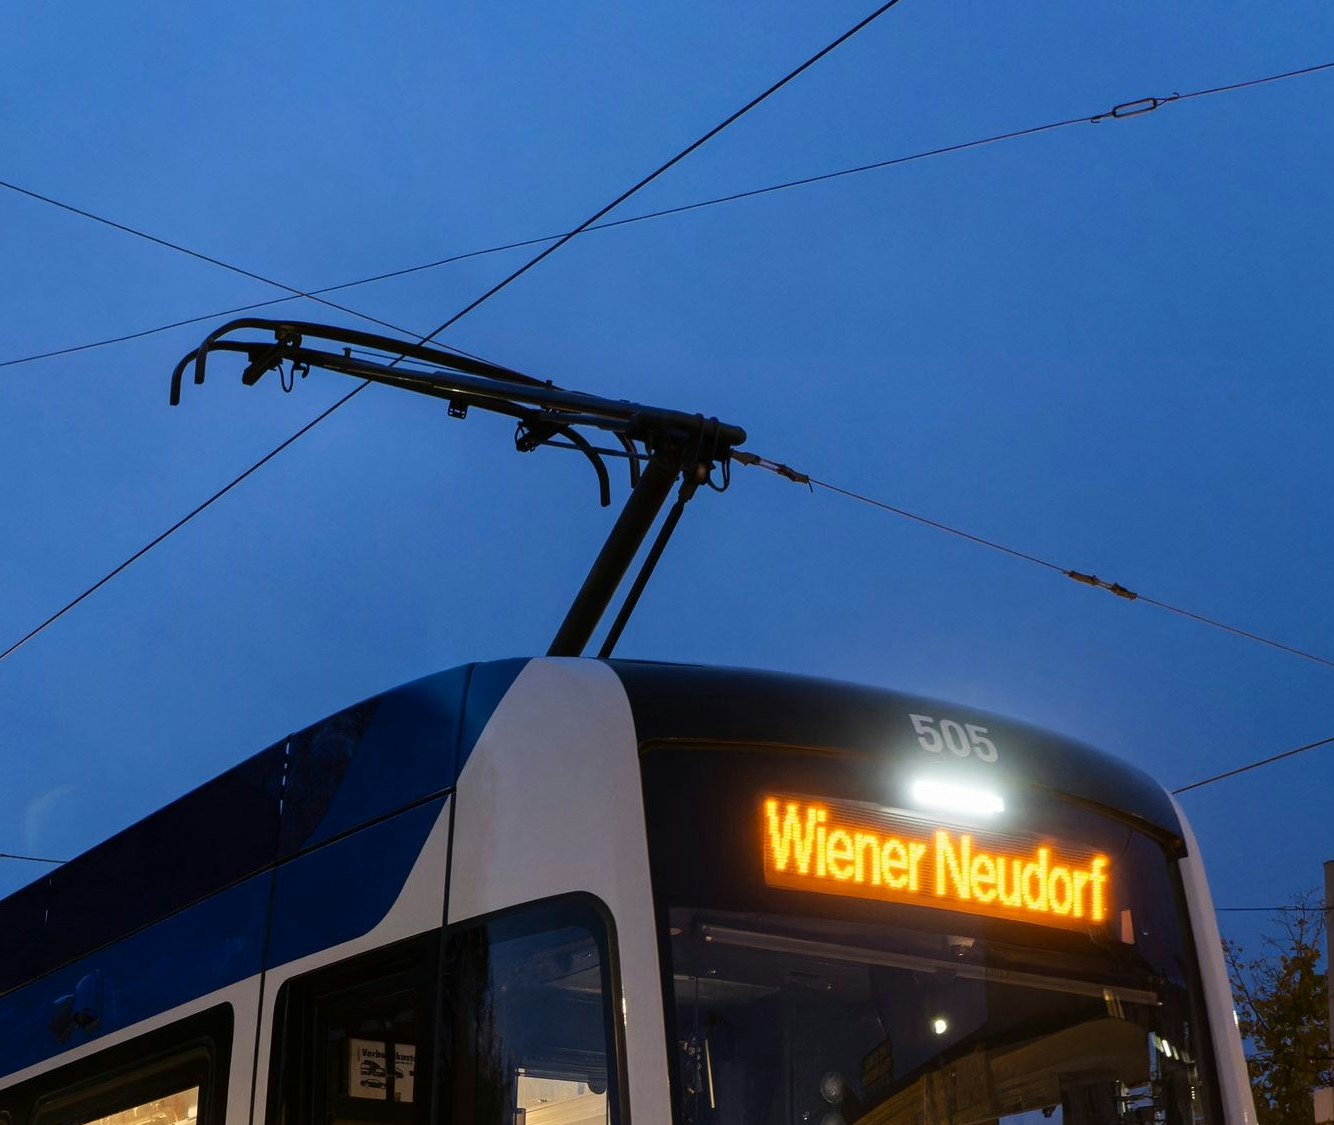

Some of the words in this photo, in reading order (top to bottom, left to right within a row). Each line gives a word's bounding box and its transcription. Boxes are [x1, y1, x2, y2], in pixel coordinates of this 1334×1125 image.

[909, 713, 999, 763] 505
[767, 800, 927, 892] Wiener
[935, 830, 1109, 921] Neudorf
